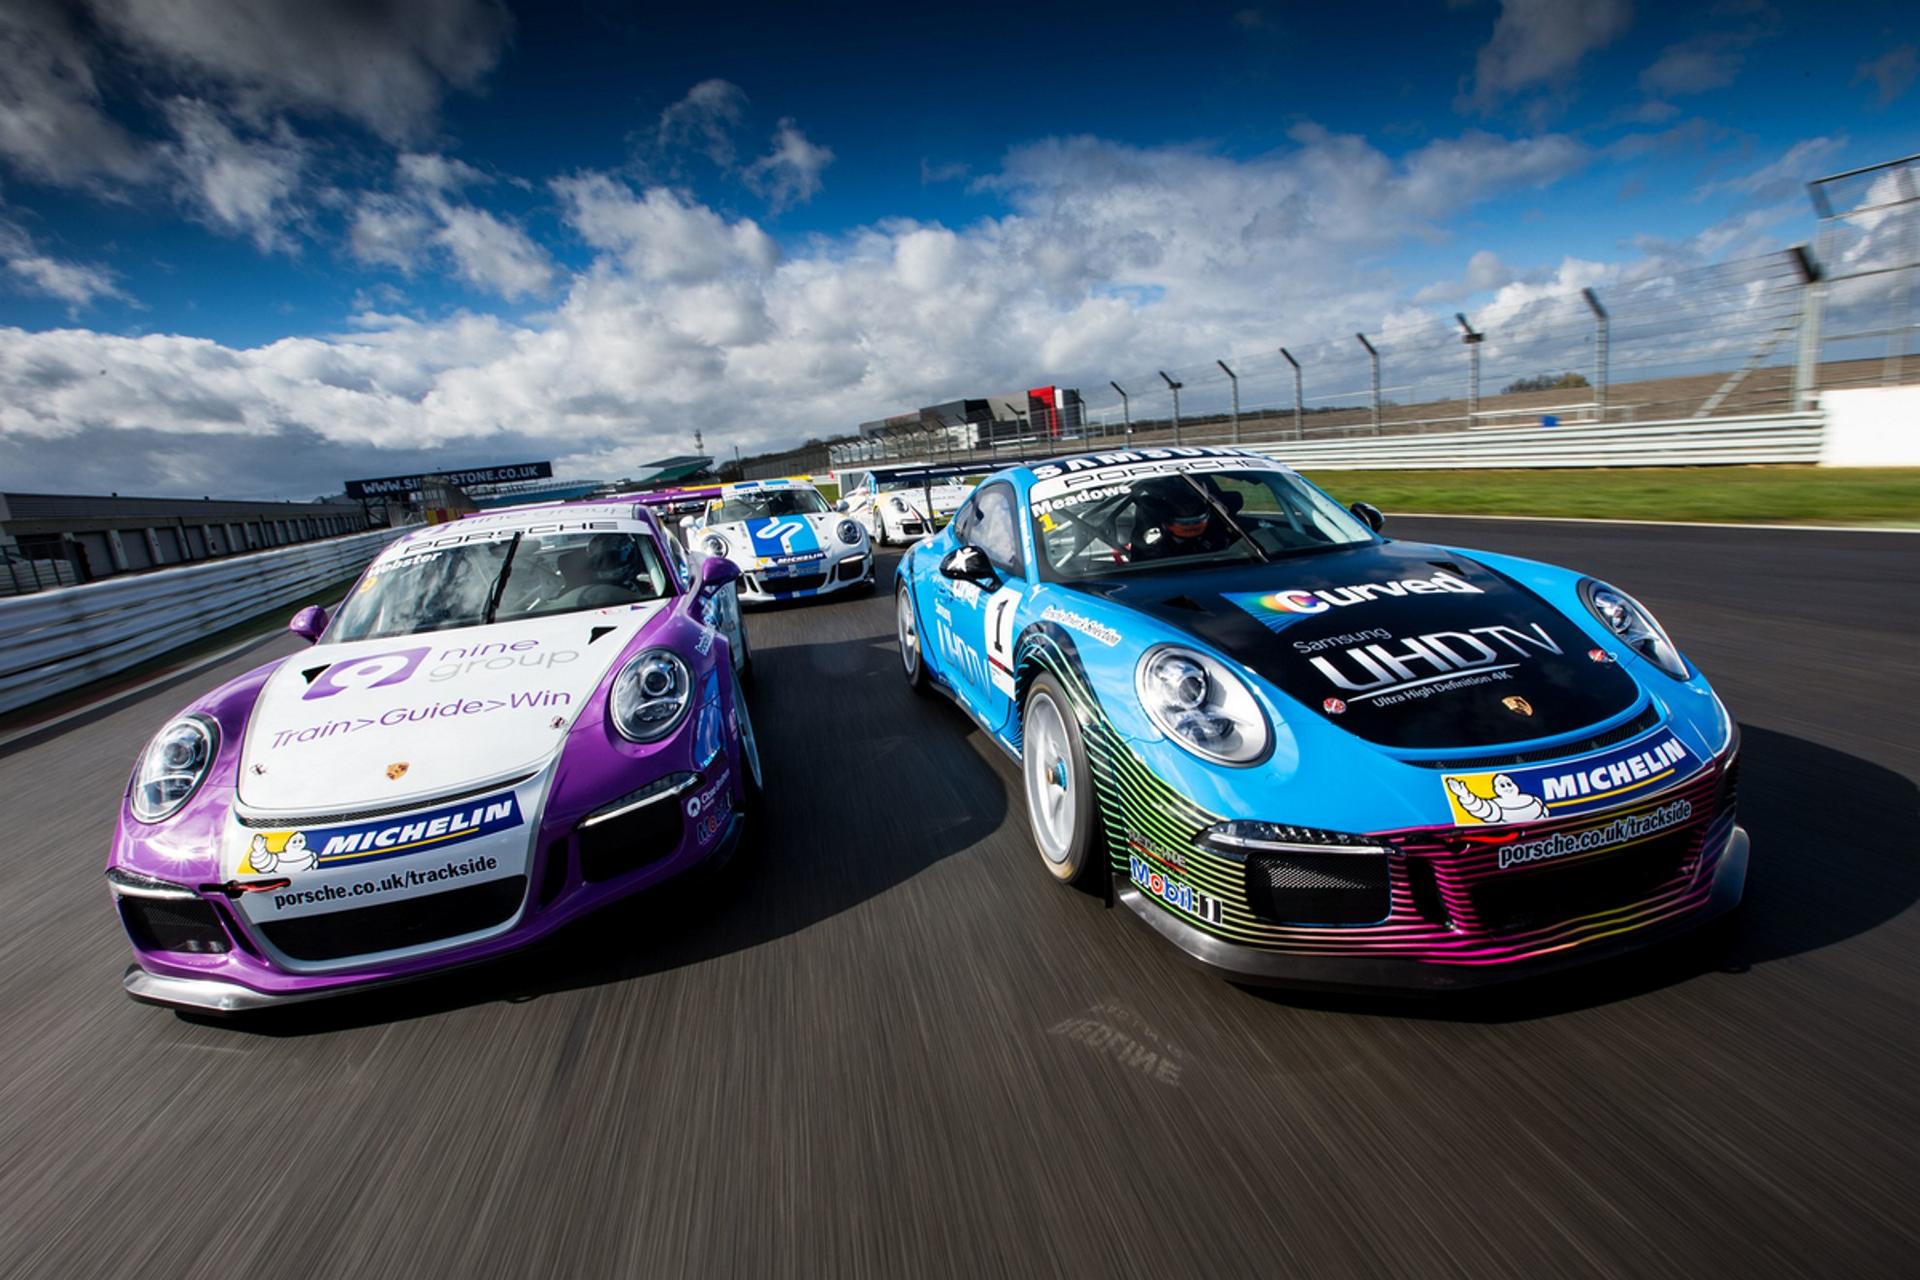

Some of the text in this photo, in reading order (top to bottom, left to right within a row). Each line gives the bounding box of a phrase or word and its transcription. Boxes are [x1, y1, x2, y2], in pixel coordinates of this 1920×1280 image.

[361, 466, 538, 494] WWW.SISTONE.CO.UK
[1064, 459, 1270, 488] PORSCHE
[1031, 484, 1132, 518] Meadows
[404, 521, 618, 555] PORSCHE
[1037, 513, 1058, 533] 1
[1274, 571, 1485, 614] Curved
[993, 599, 1009, 654] 1
[1293, 626, 1392, 655] Samsung
[429, 650, 579, 683] group
[440, 639, 539, 662] nine
[1372, 692, 1406, 708] Ultra
[1404, 686, 1436, 699] High
[1434, 674, 1492, 694] Definition
[1542, 737, 1687, 801] MICHELIN
[320, 799, 513, 856] MICHELIN
[1499, 800, 1692, 868] porsche.co.uk/trackside
[274, 855, 498, 910] porsche.co.uk/trackside
[1129, 855, 1193, 914] Mobil
